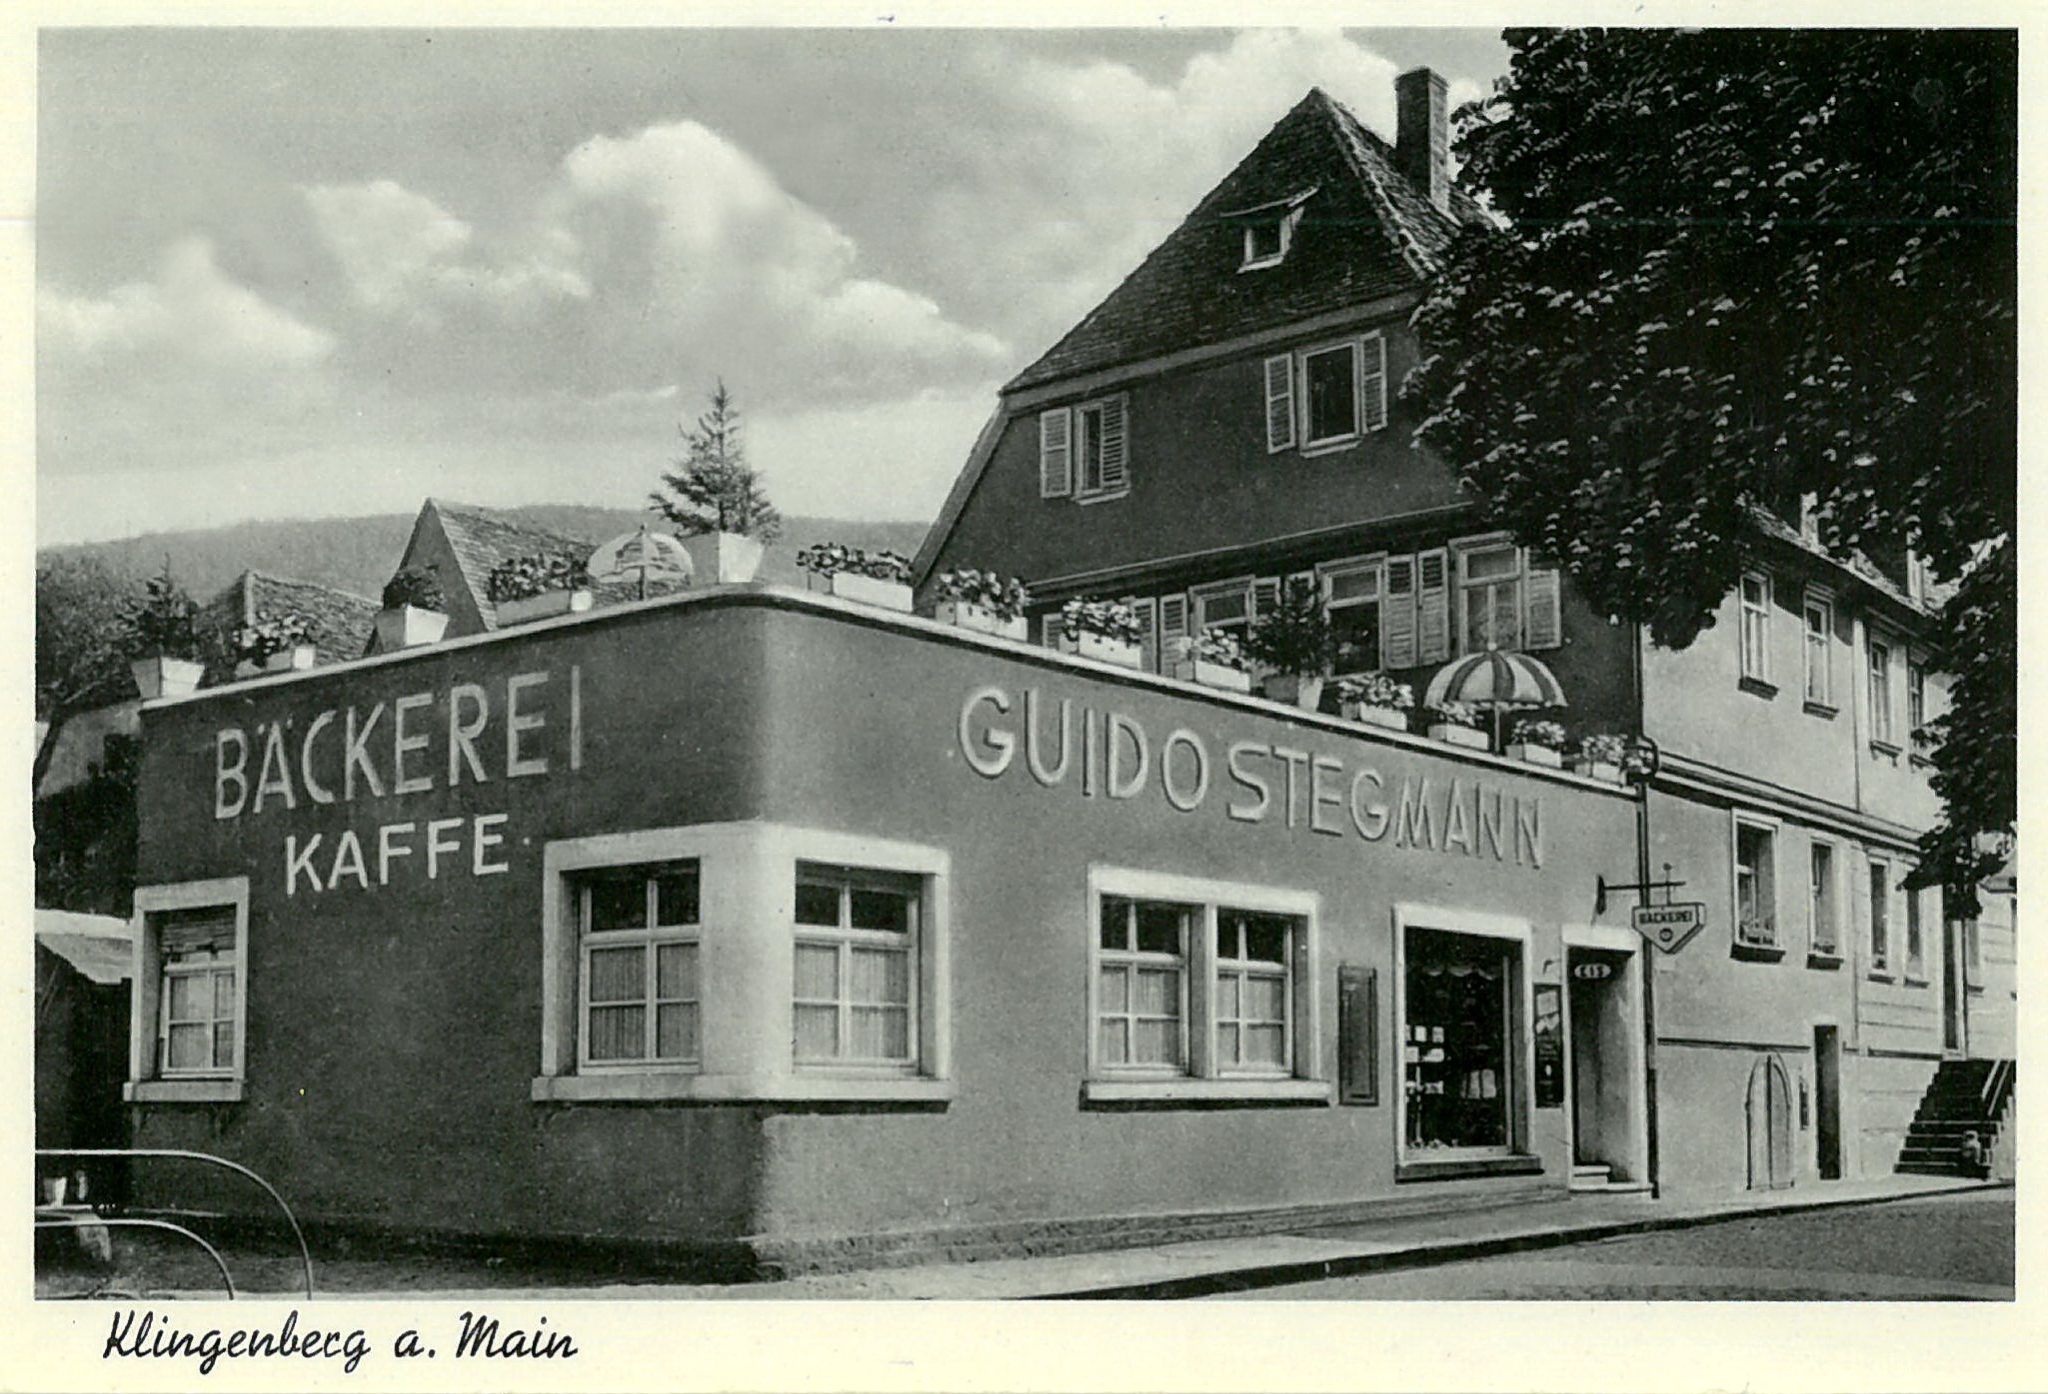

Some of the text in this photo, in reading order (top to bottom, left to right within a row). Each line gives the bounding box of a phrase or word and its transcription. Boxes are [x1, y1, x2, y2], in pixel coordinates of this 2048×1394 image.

[214, 666, 581, 819] BÄCKEREI
[958, 687, 1545, 869] GUIDO STEGMANN
[286, 813, 508, 898] KAFFE
